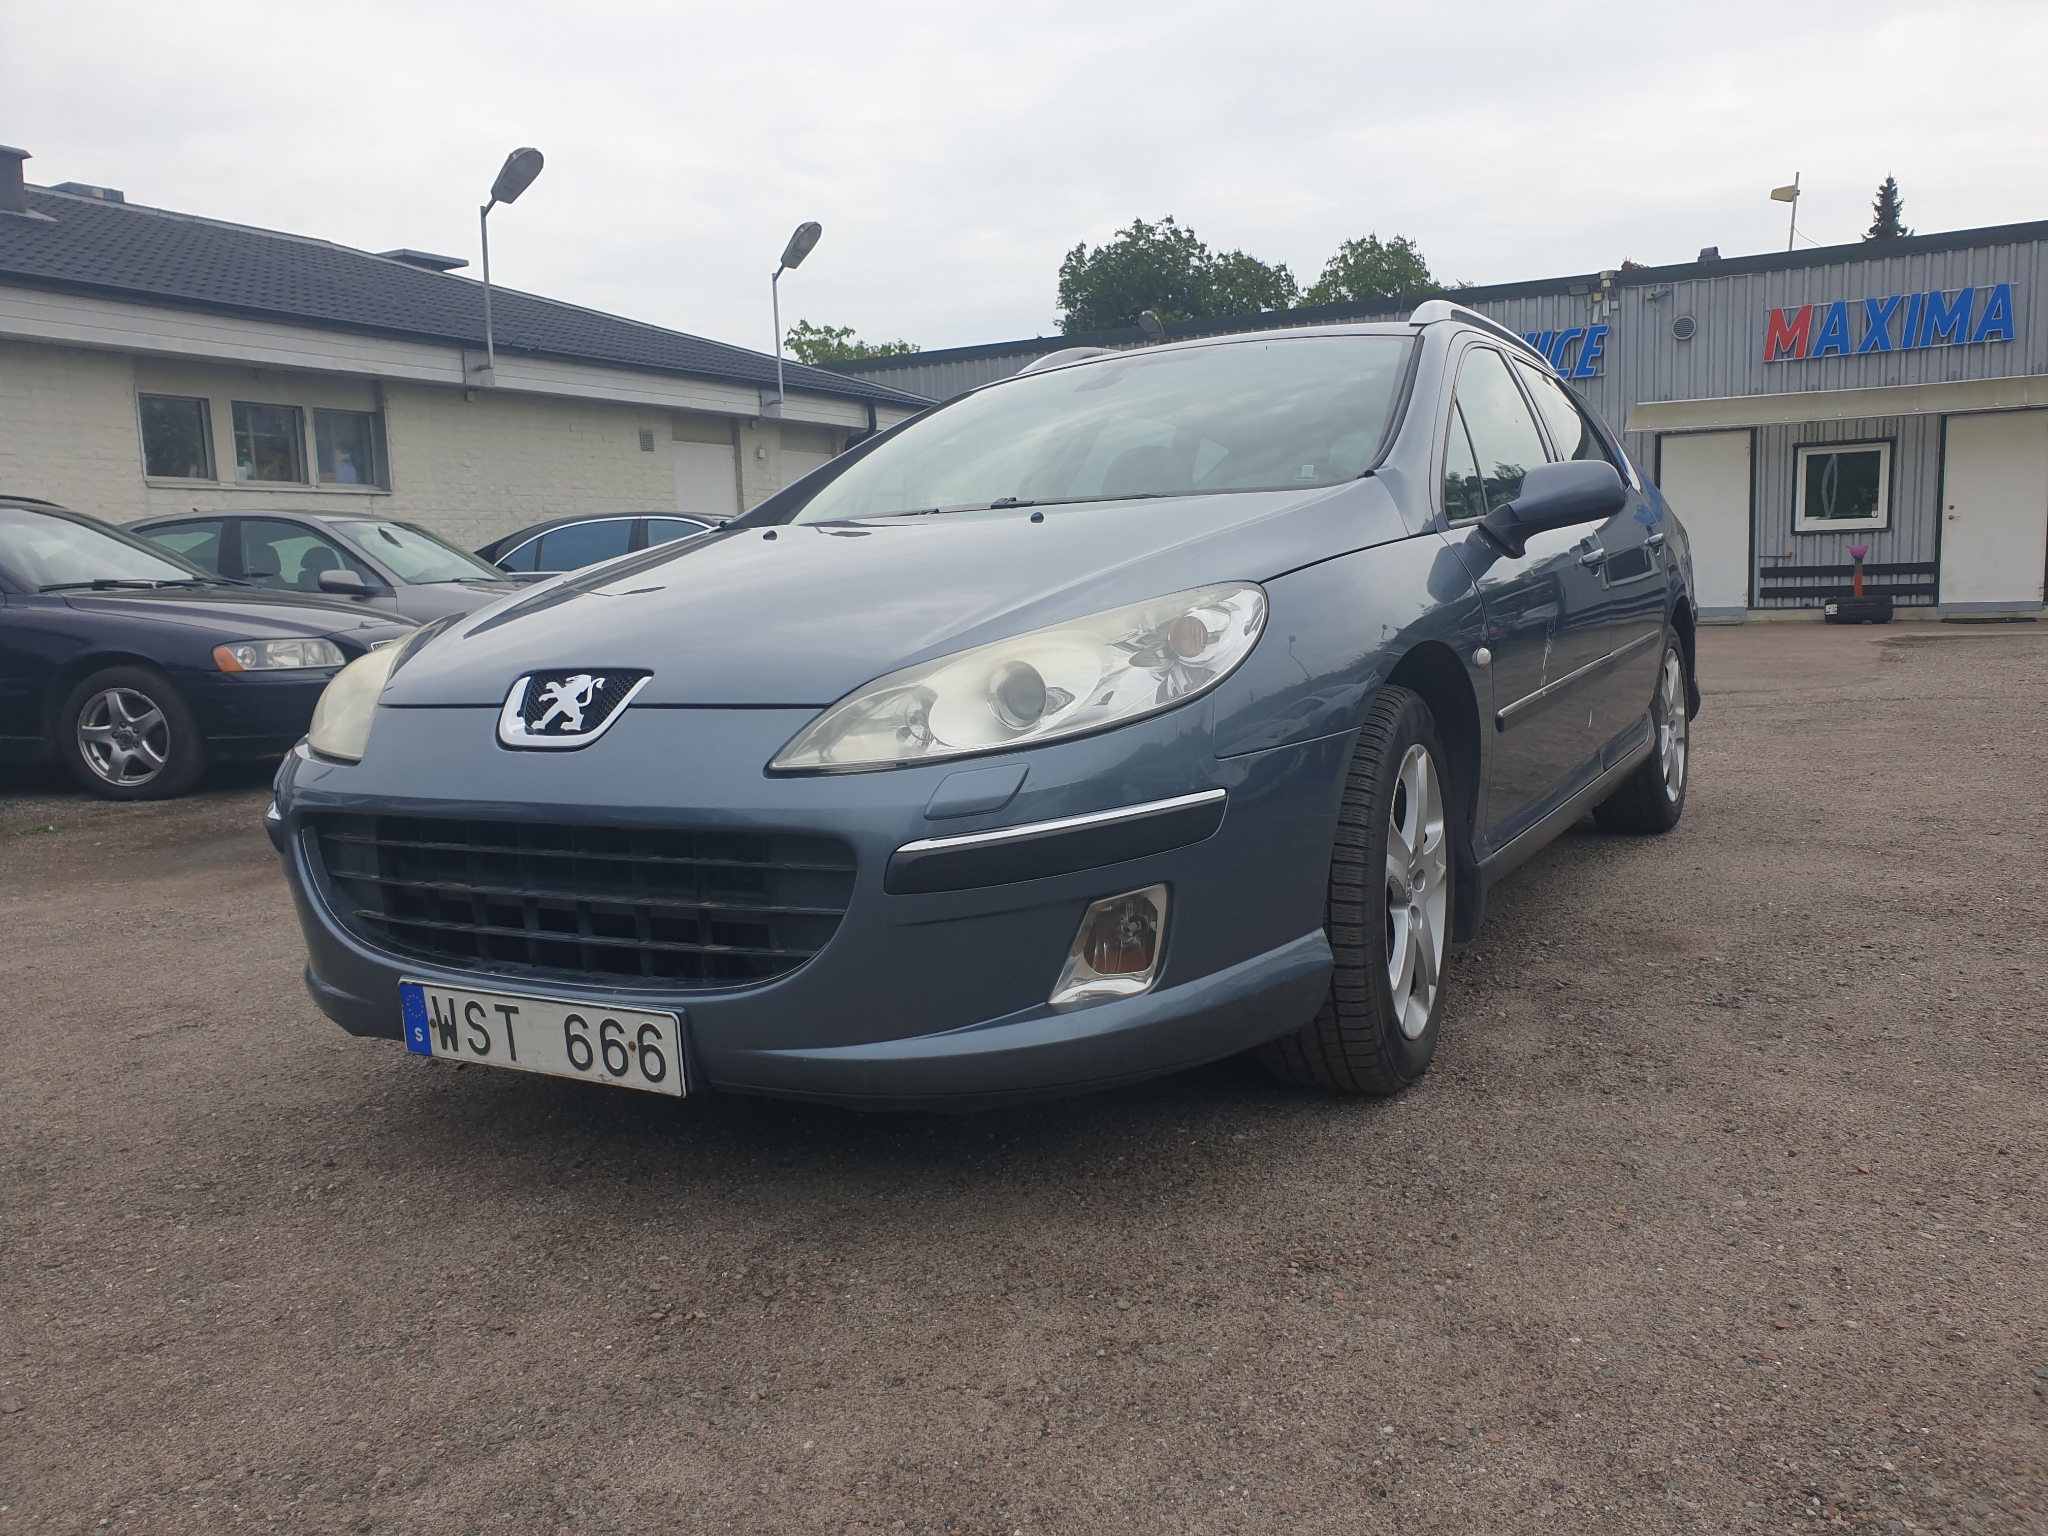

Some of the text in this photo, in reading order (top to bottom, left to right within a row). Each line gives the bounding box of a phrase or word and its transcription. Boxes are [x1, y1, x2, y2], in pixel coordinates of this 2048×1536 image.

[1763, 283, 2016, 362] MAXIMA
[414, 1027, 424, 1042] S
[431, 995, 667, 1083] WST 666
